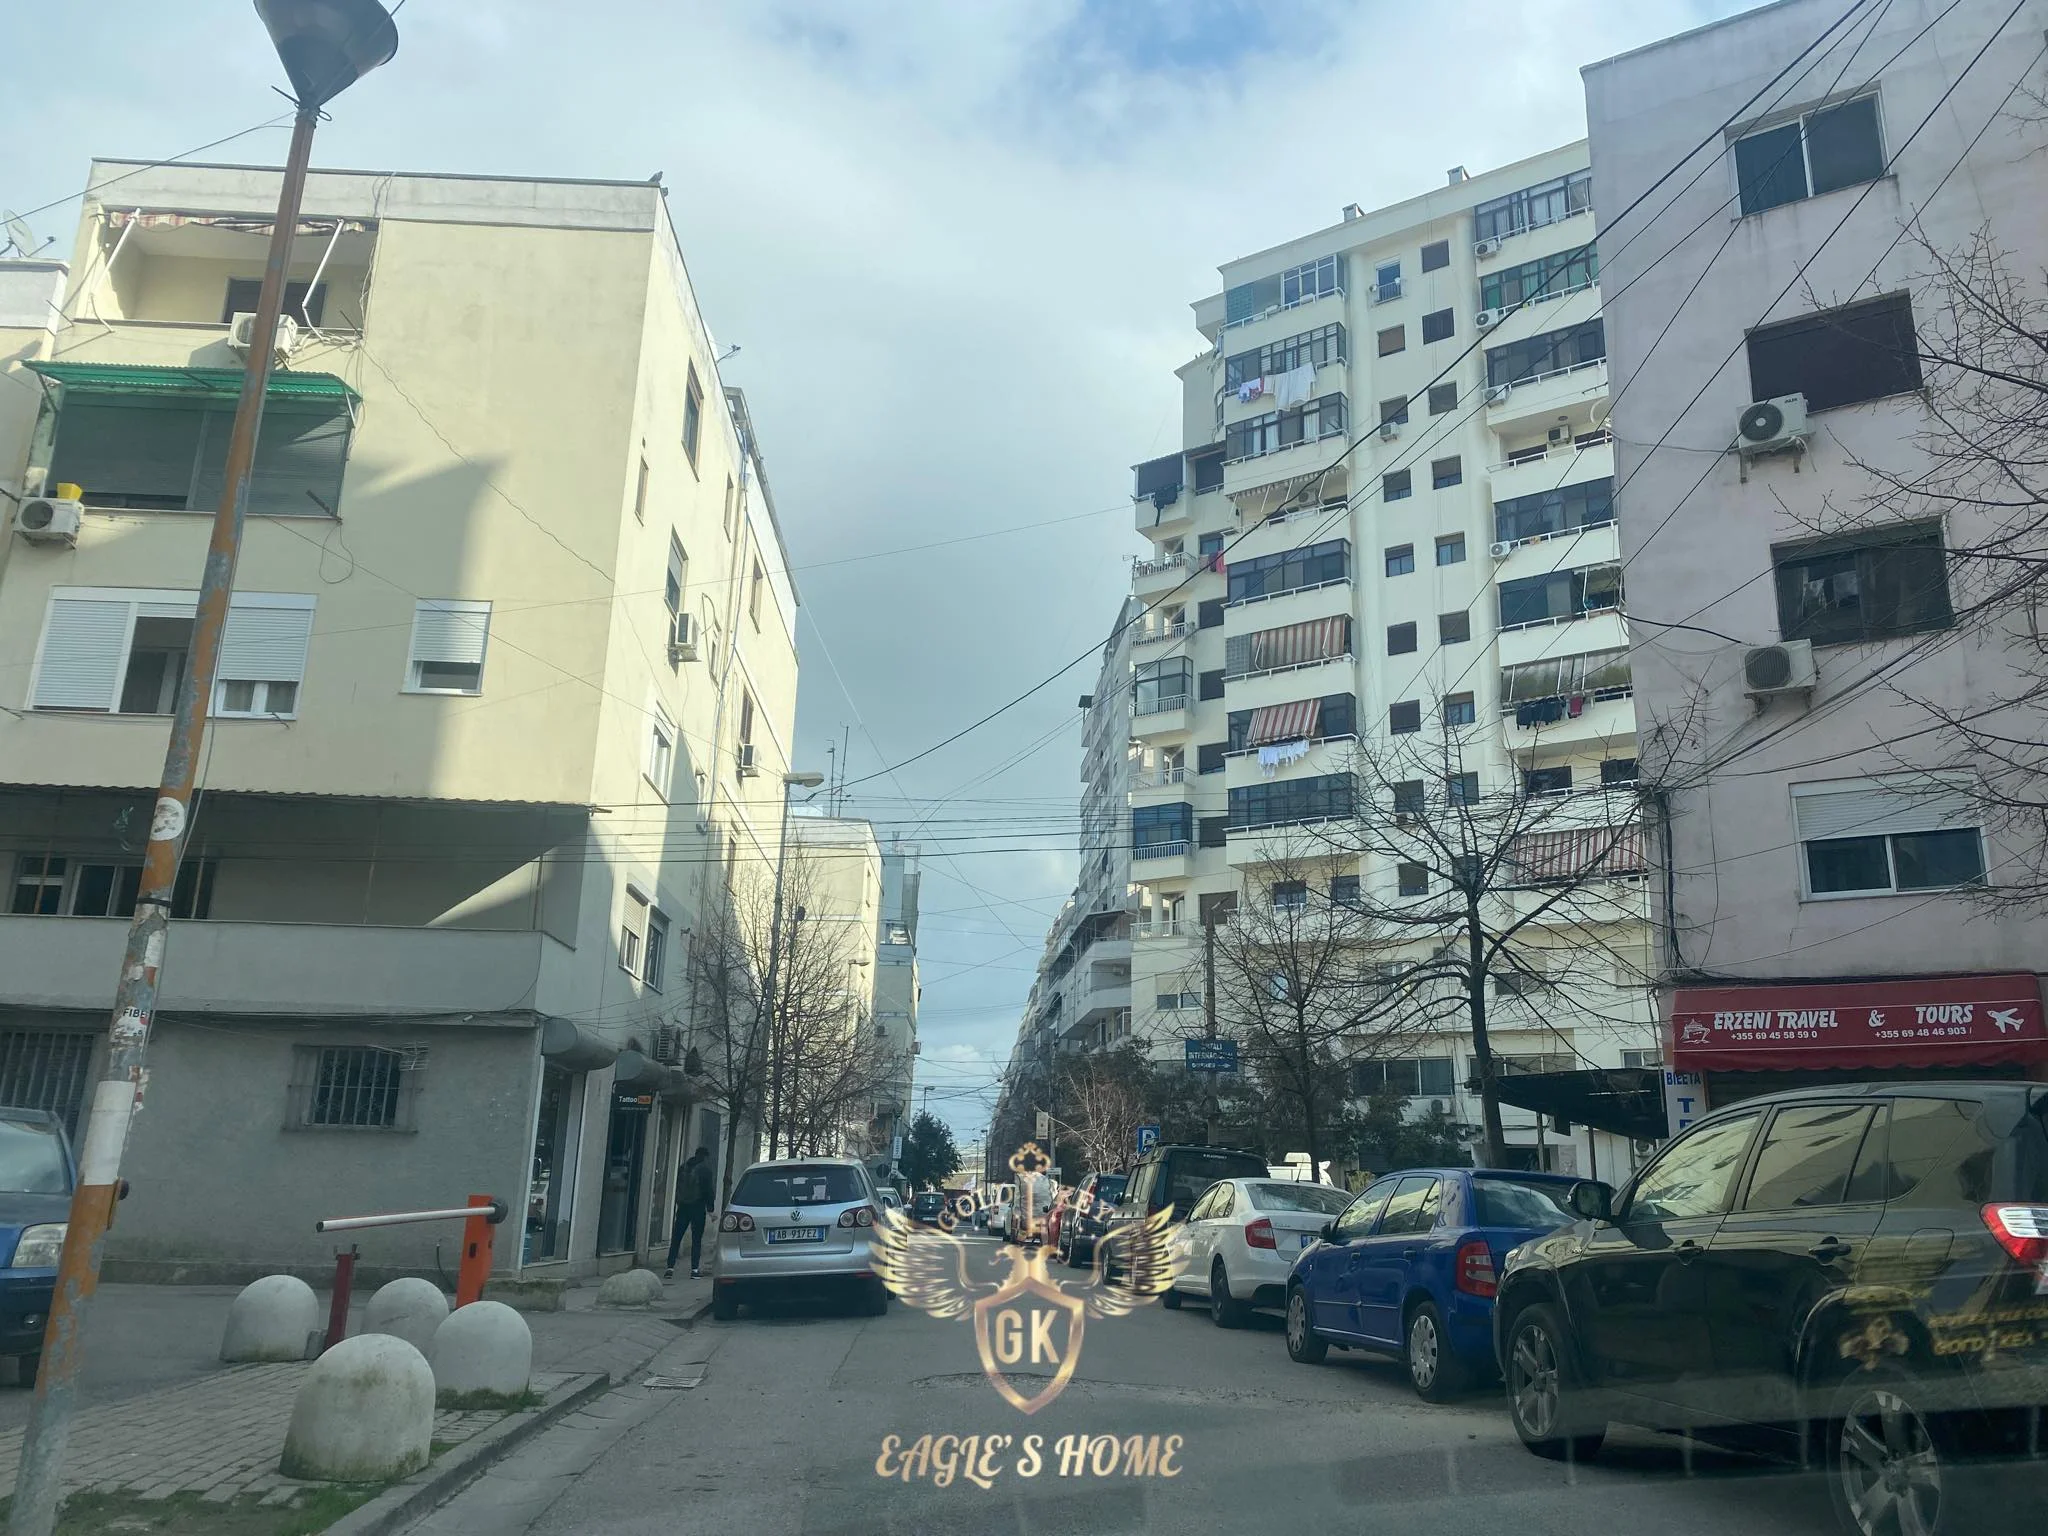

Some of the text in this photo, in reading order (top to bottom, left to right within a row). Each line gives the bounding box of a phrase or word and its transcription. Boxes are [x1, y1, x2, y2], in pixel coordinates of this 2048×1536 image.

[1714, 1004, 1974, 1031] ERZENI TRAVEL & TOURS
[1731, 1030, 1818, 1040] +355 69 45 58 59 0
[1875, 1030, 1899, 1039] +355
[1901, 1029, 1914, 1038] 69
[1916, 1028, 1930, 1036] 48
[1932, 1027, 1945, 1036] 46
[1947, 1026, 1967, 1035] 903
[618, 1095, 638, 1103] Tattoo
